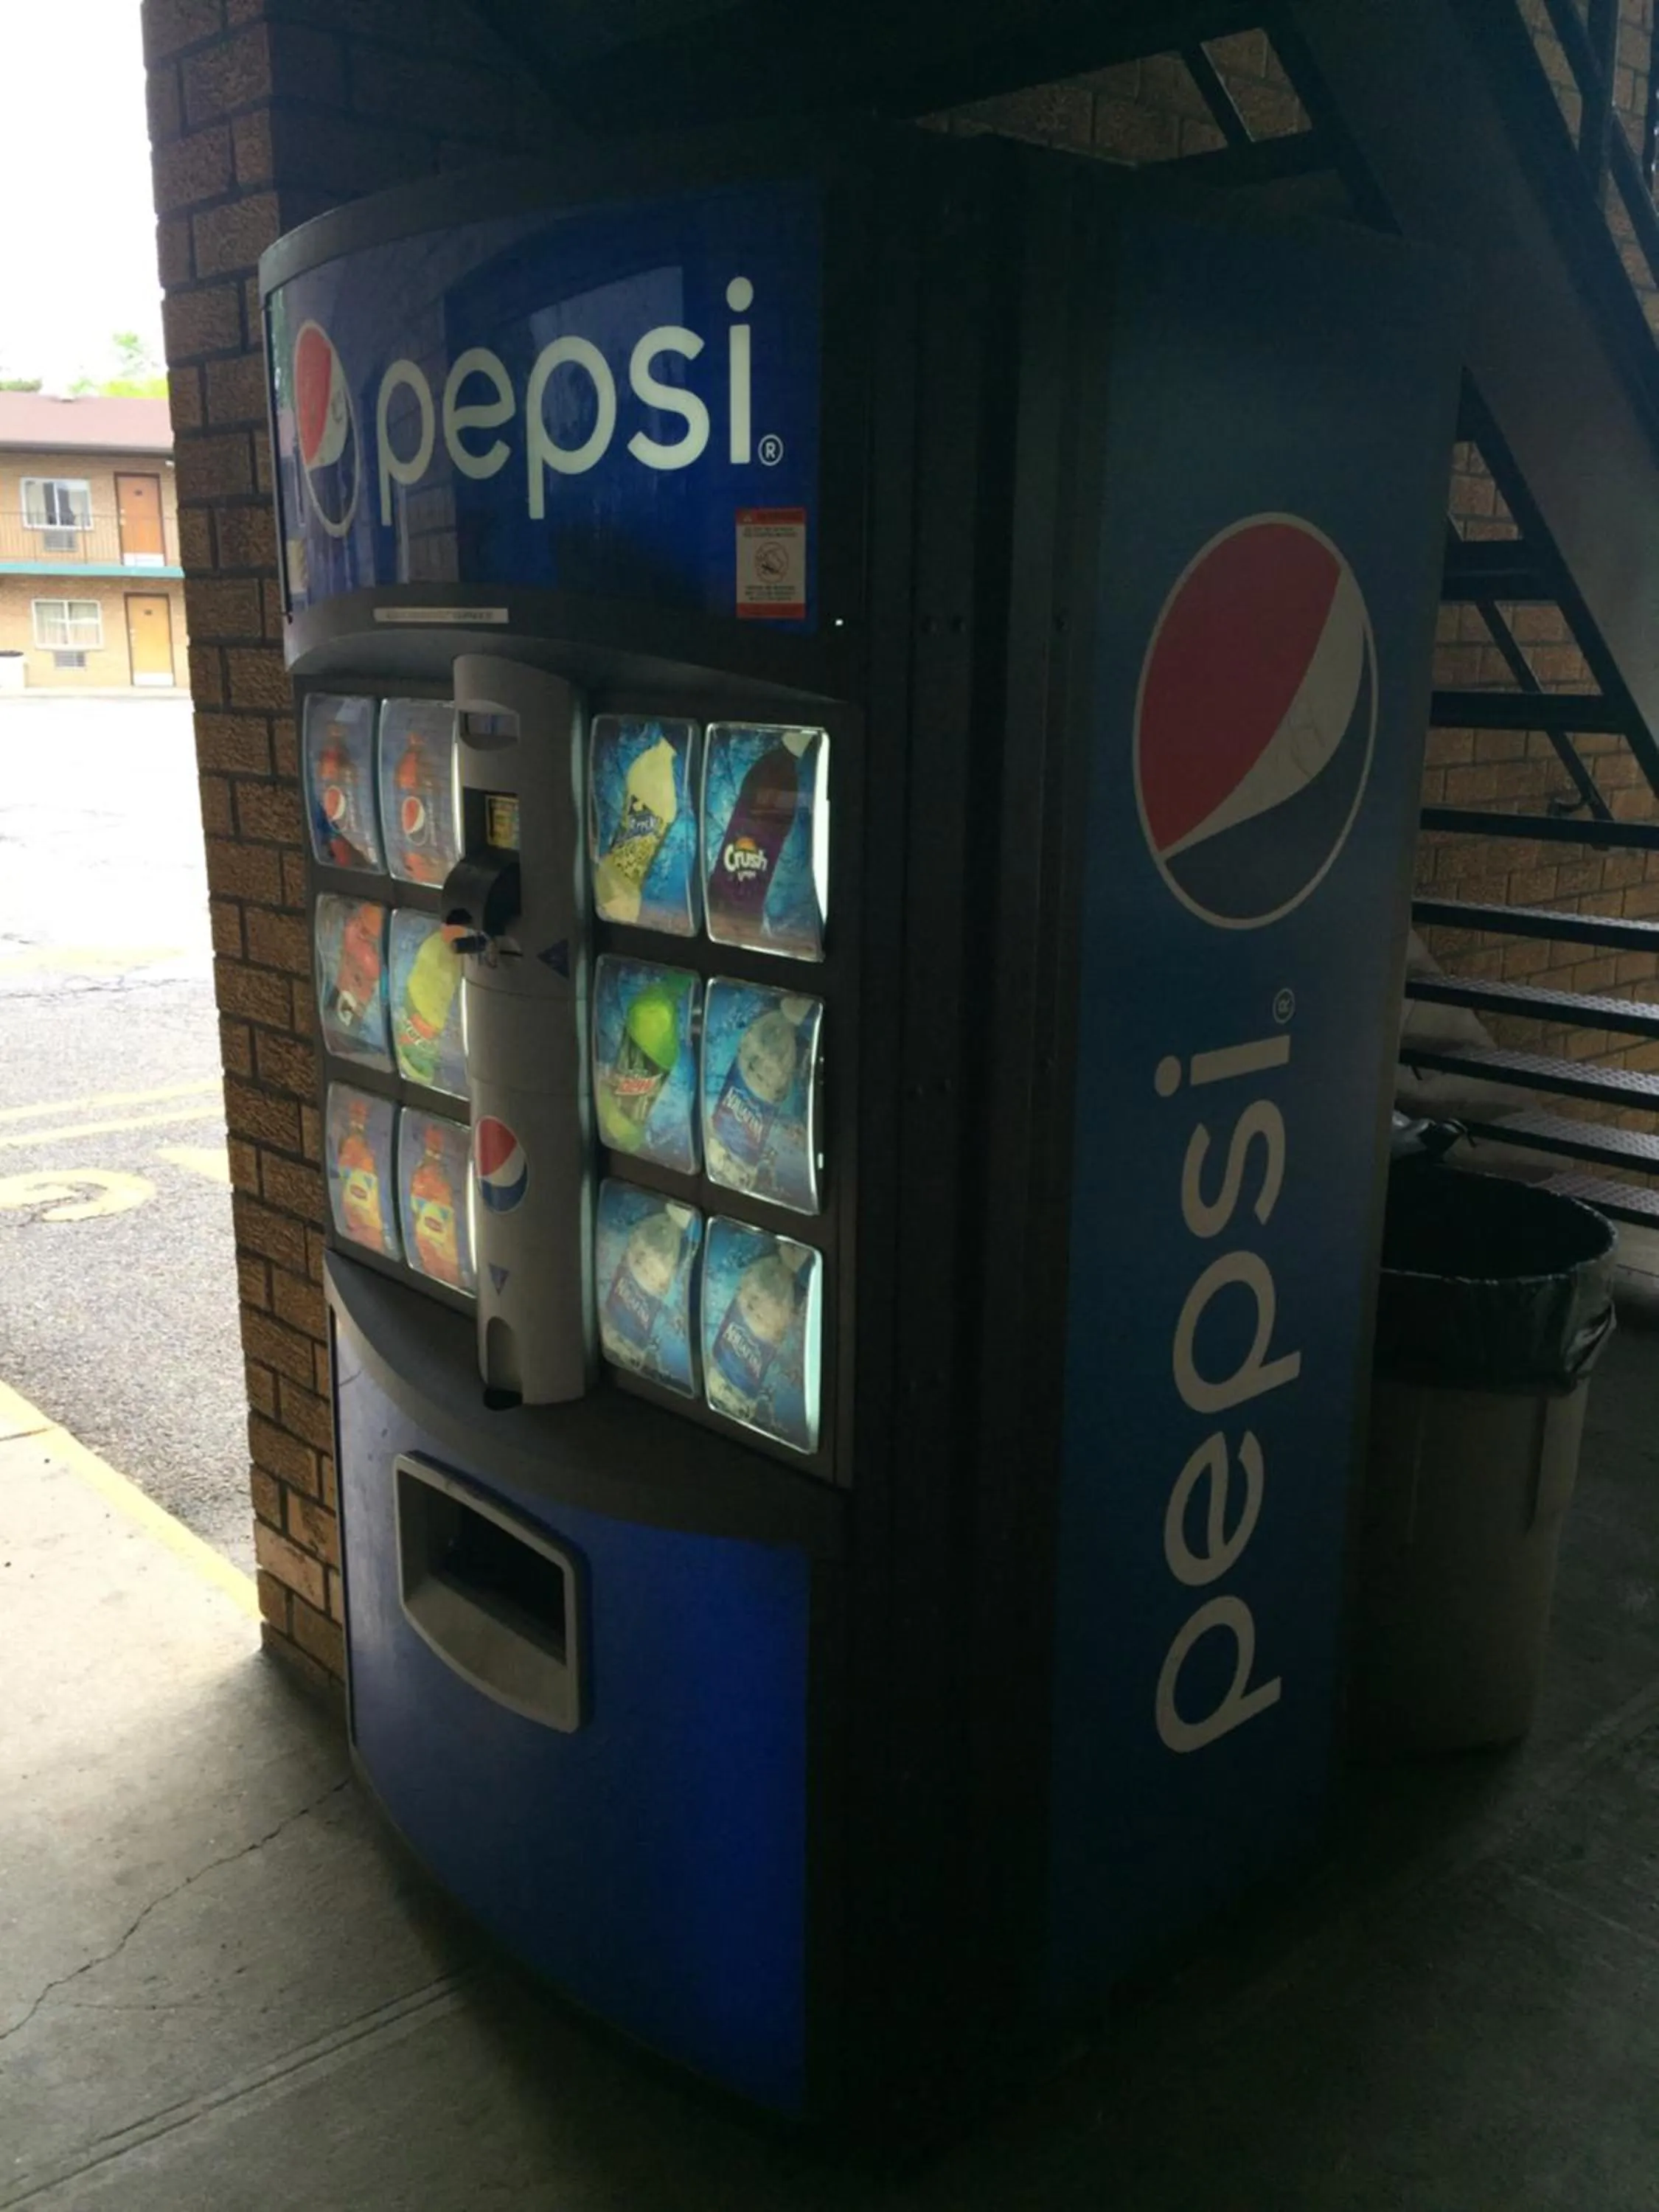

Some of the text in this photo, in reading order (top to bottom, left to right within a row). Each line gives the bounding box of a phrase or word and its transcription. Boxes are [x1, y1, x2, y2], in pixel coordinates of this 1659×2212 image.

[376, 276, 754, 526] pepsi
[723, 844, 768, 873] Crush
[1155, 1034, 1301, 1753] pepsi
